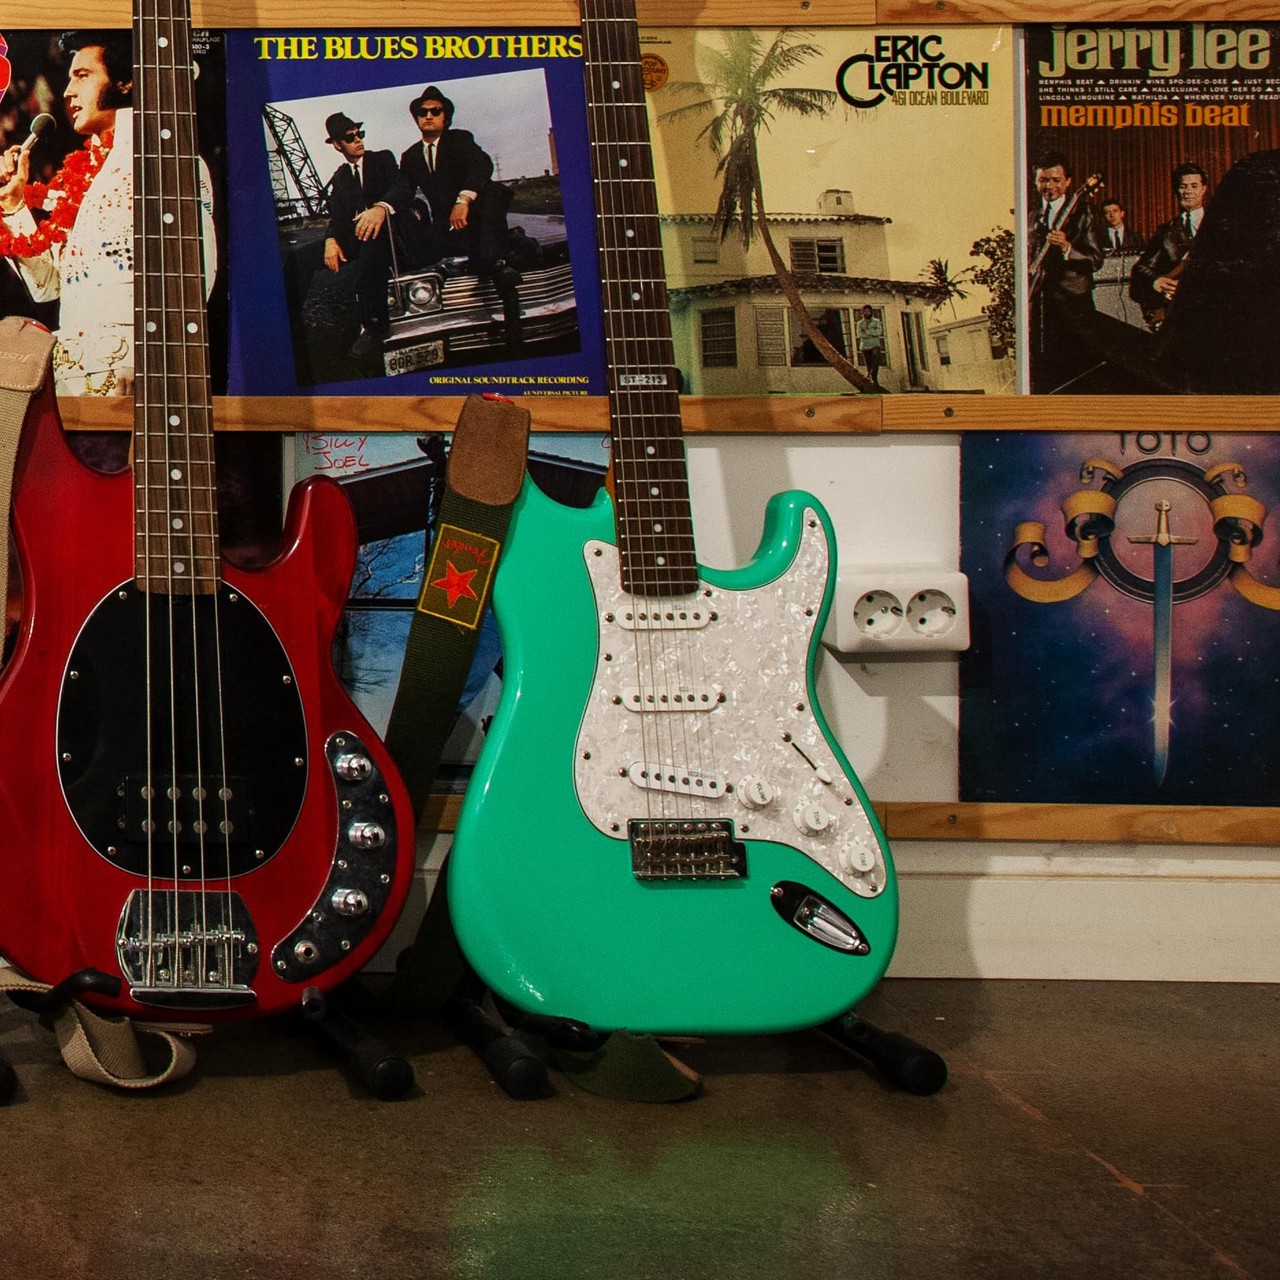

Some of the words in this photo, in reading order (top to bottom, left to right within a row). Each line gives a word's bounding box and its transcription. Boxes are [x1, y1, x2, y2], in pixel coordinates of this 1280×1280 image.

[254, 35, 318, 61] THE
[323, 35, 419, 60] BLUES
[426, 33, 583, 59] BROTHERS
[874, 34, 946, 63] ERIC
[1038, 24, 1182, 78] jerry
[1189, 22, 1271, 71] lee
[836, 53, 990, 109] CLAPTON
[909, 91, 938, 105] OCEAN
[940, 91, 990, 106] BOULEVARD
[1040, 101, 1179, 131] memphis
[1184, 101, 1251, 128] beat
[429, 377, 473, 385] ORIGINAL
[473, 377, 536, 385] SOUNDTRACK
[537, 376, 590, 384] RECORDING
[1114, 430, 1214, 455] TOTO
